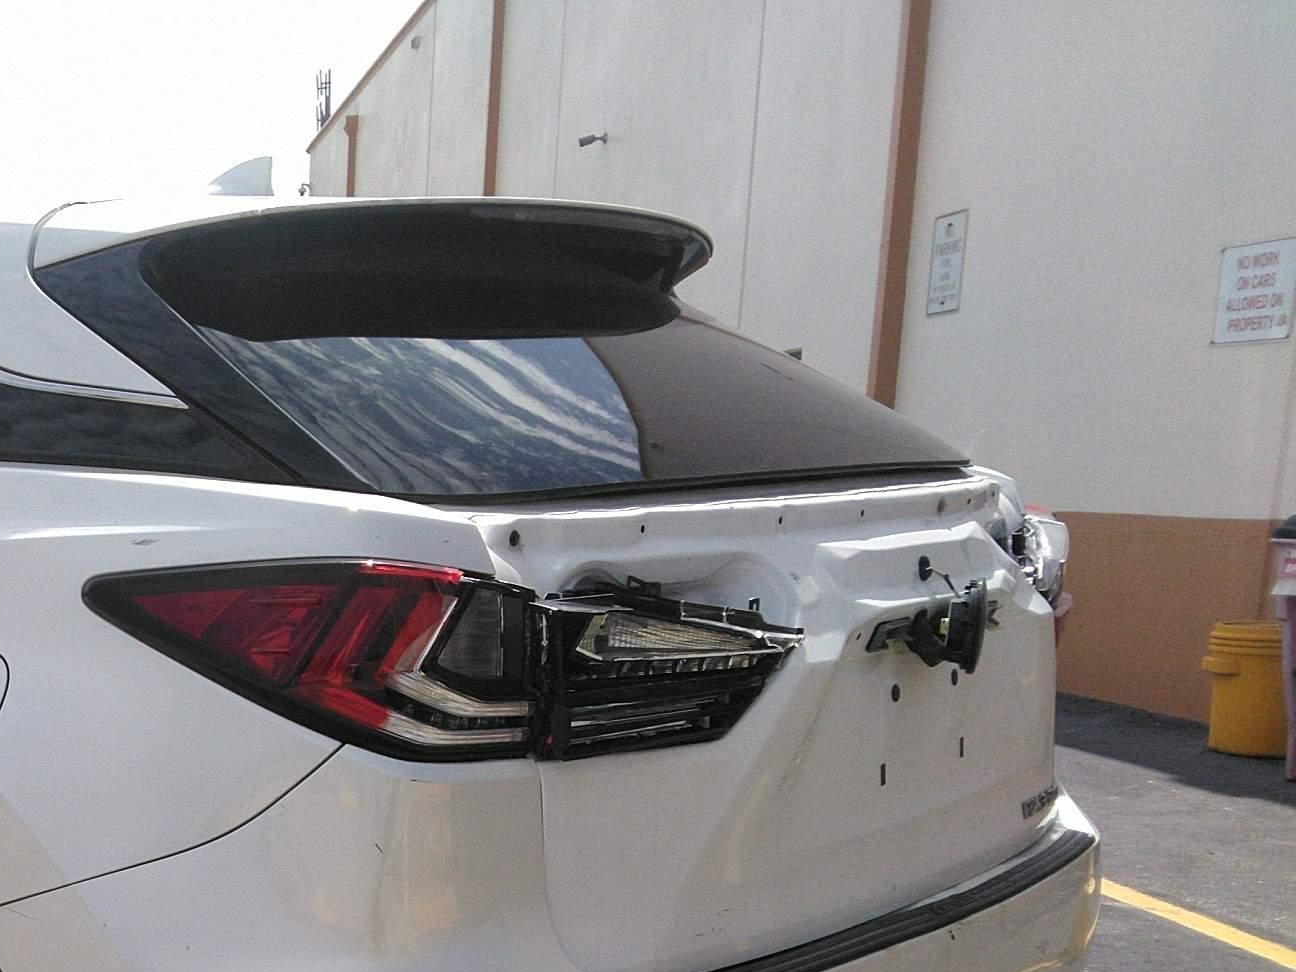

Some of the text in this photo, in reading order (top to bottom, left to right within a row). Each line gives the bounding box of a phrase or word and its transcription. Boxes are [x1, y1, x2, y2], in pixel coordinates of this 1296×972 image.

[1251, 272, 1277, 289] CARS
[1226, 294, 1269, 312] ALLOWED
[1227, 315, 1274, 332] PROPERTY
